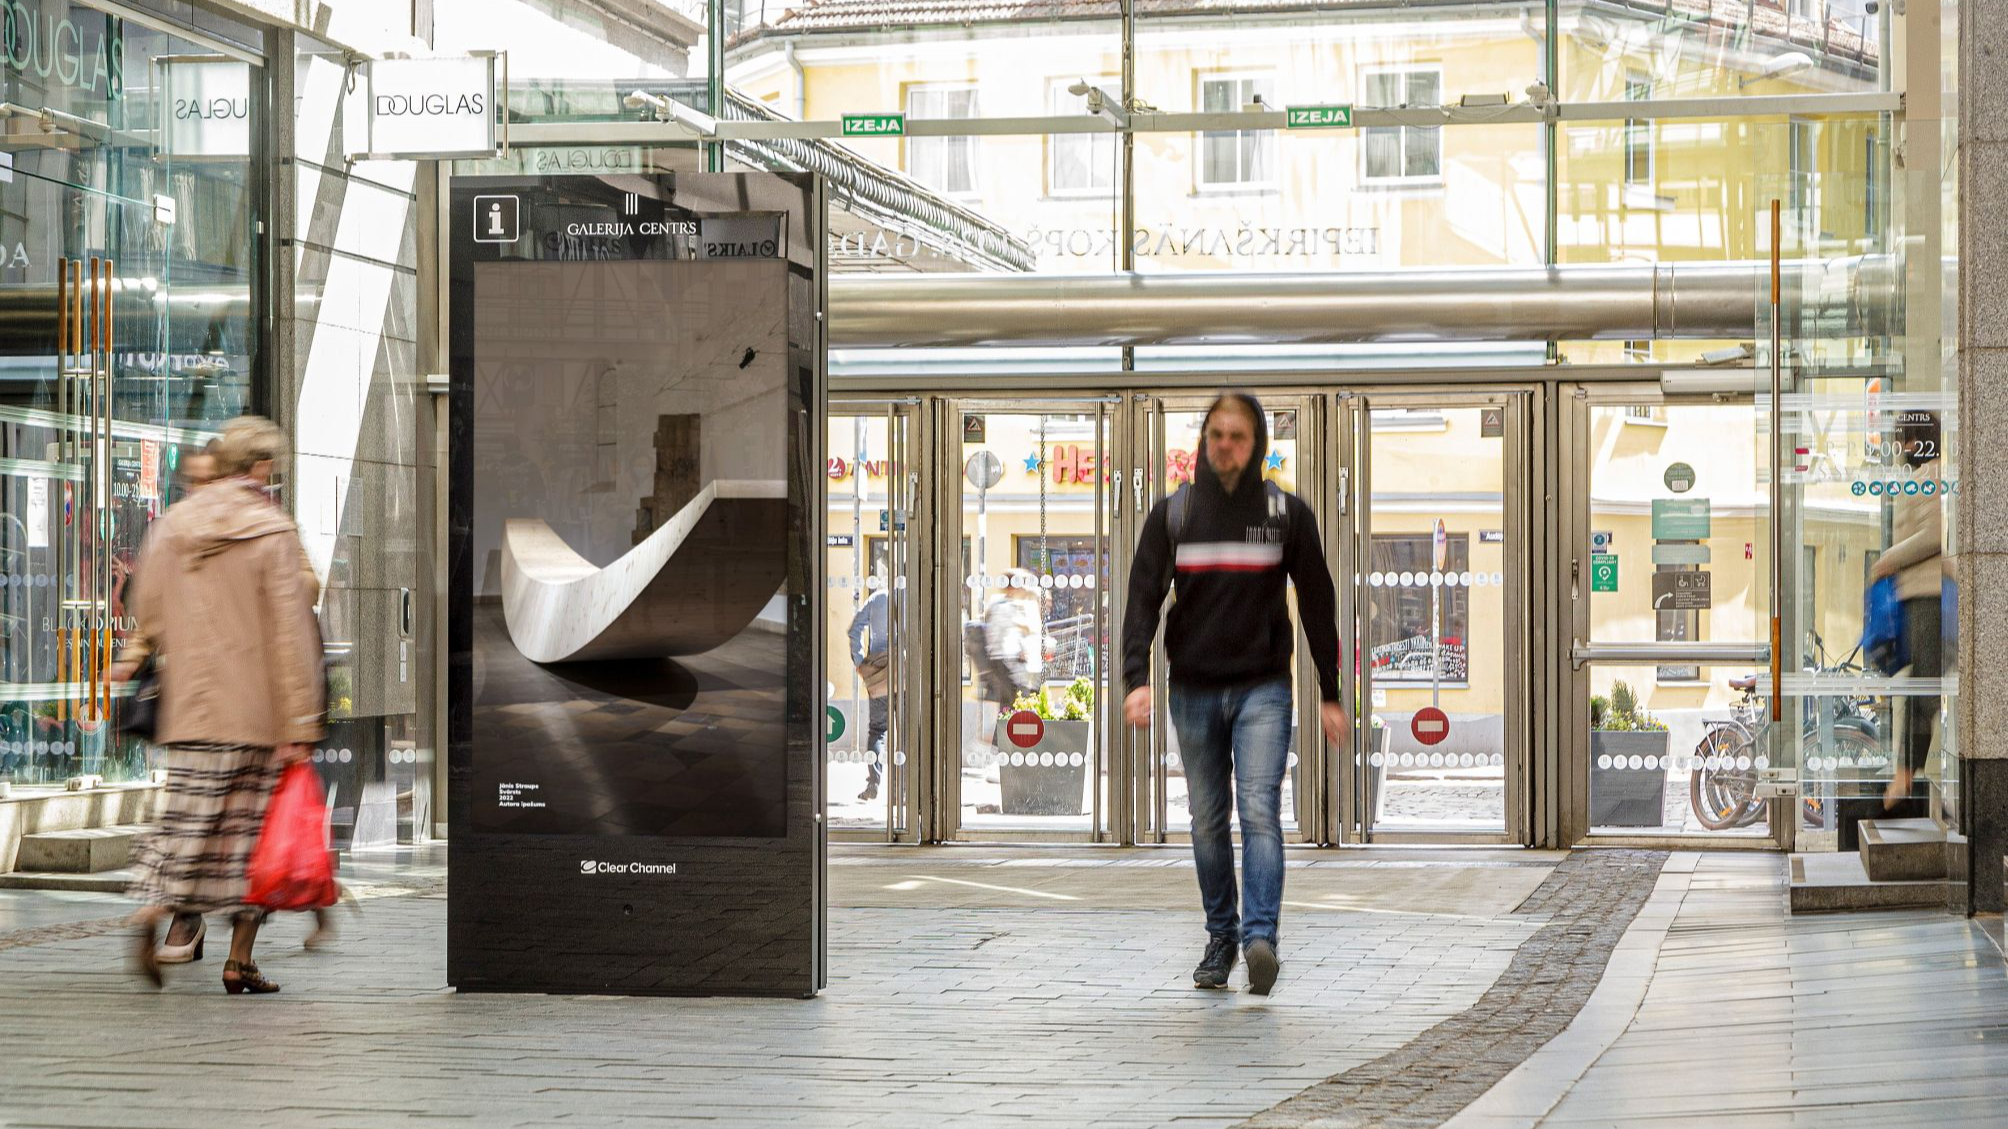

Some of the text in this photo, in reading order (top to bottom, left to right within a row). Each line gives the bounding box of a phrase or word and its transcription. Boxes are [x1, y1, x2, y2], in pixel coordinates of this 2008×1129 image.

[376, 93, 484, 116] DOUGLAS
[1290, 110, 1347, 124] IZEJA
[845, 119, 900, 132] IZEJA
[567, 223, 635, 238] GALERIJA
[598, 862, 676, 874] Clear Channel
